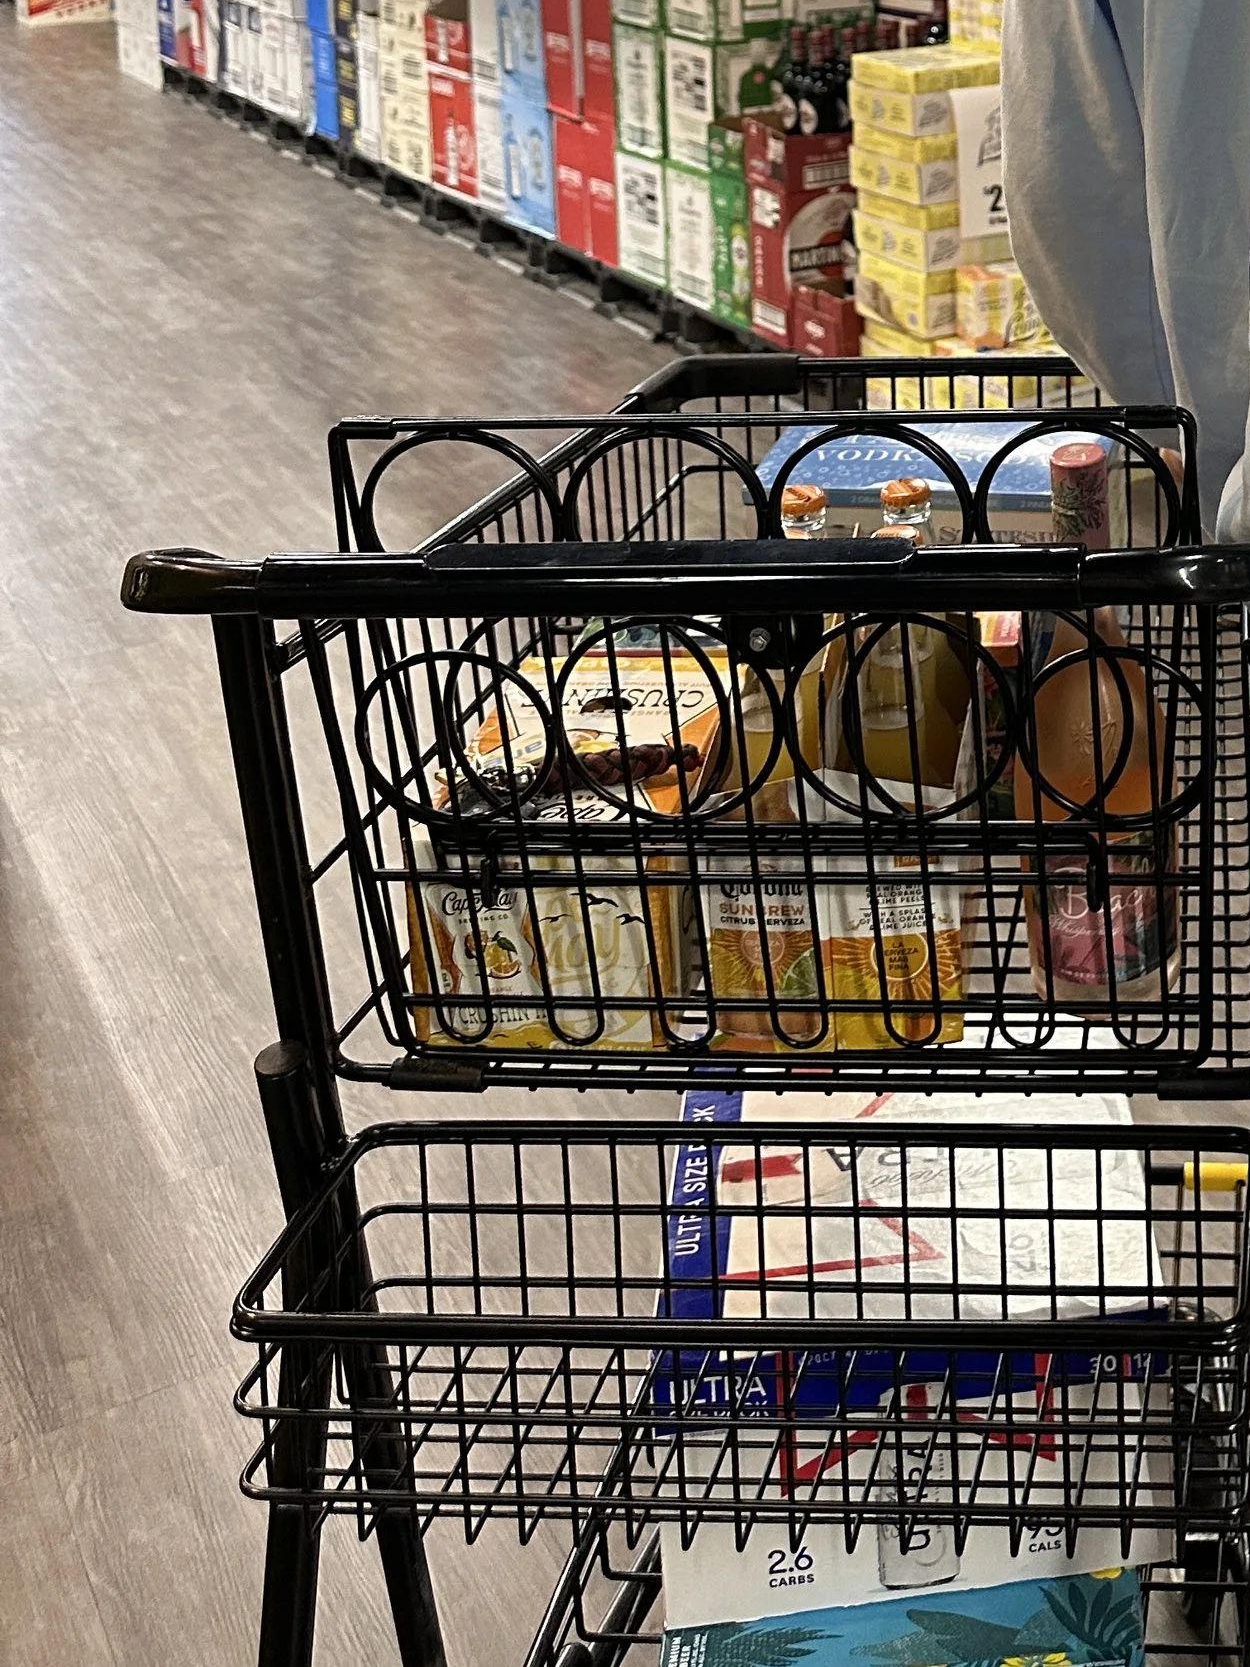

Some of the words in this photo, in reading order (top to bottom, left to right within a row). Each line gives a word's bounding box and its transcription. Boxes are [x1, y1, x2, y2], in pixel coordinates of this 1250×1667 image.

[791, 244, 845, 270] MARTIN
[816, 448, 926, 463] VODK
[441, 890, 482, 916] Cape
[719, 903, 805, 916] SUNREW
[720, 916, 756, 926] CITRUS
[765, 917, 805, 926] ERVEZA
[884, 948, 919, 956] ERVEZA
[683, 1155, 709, 1194] SIZE
[1028, 1540, 1062, 1553] CALS
[768, 1550, 814, 1575] 2.6
[768, 1574, 815, 1588] CARBS
